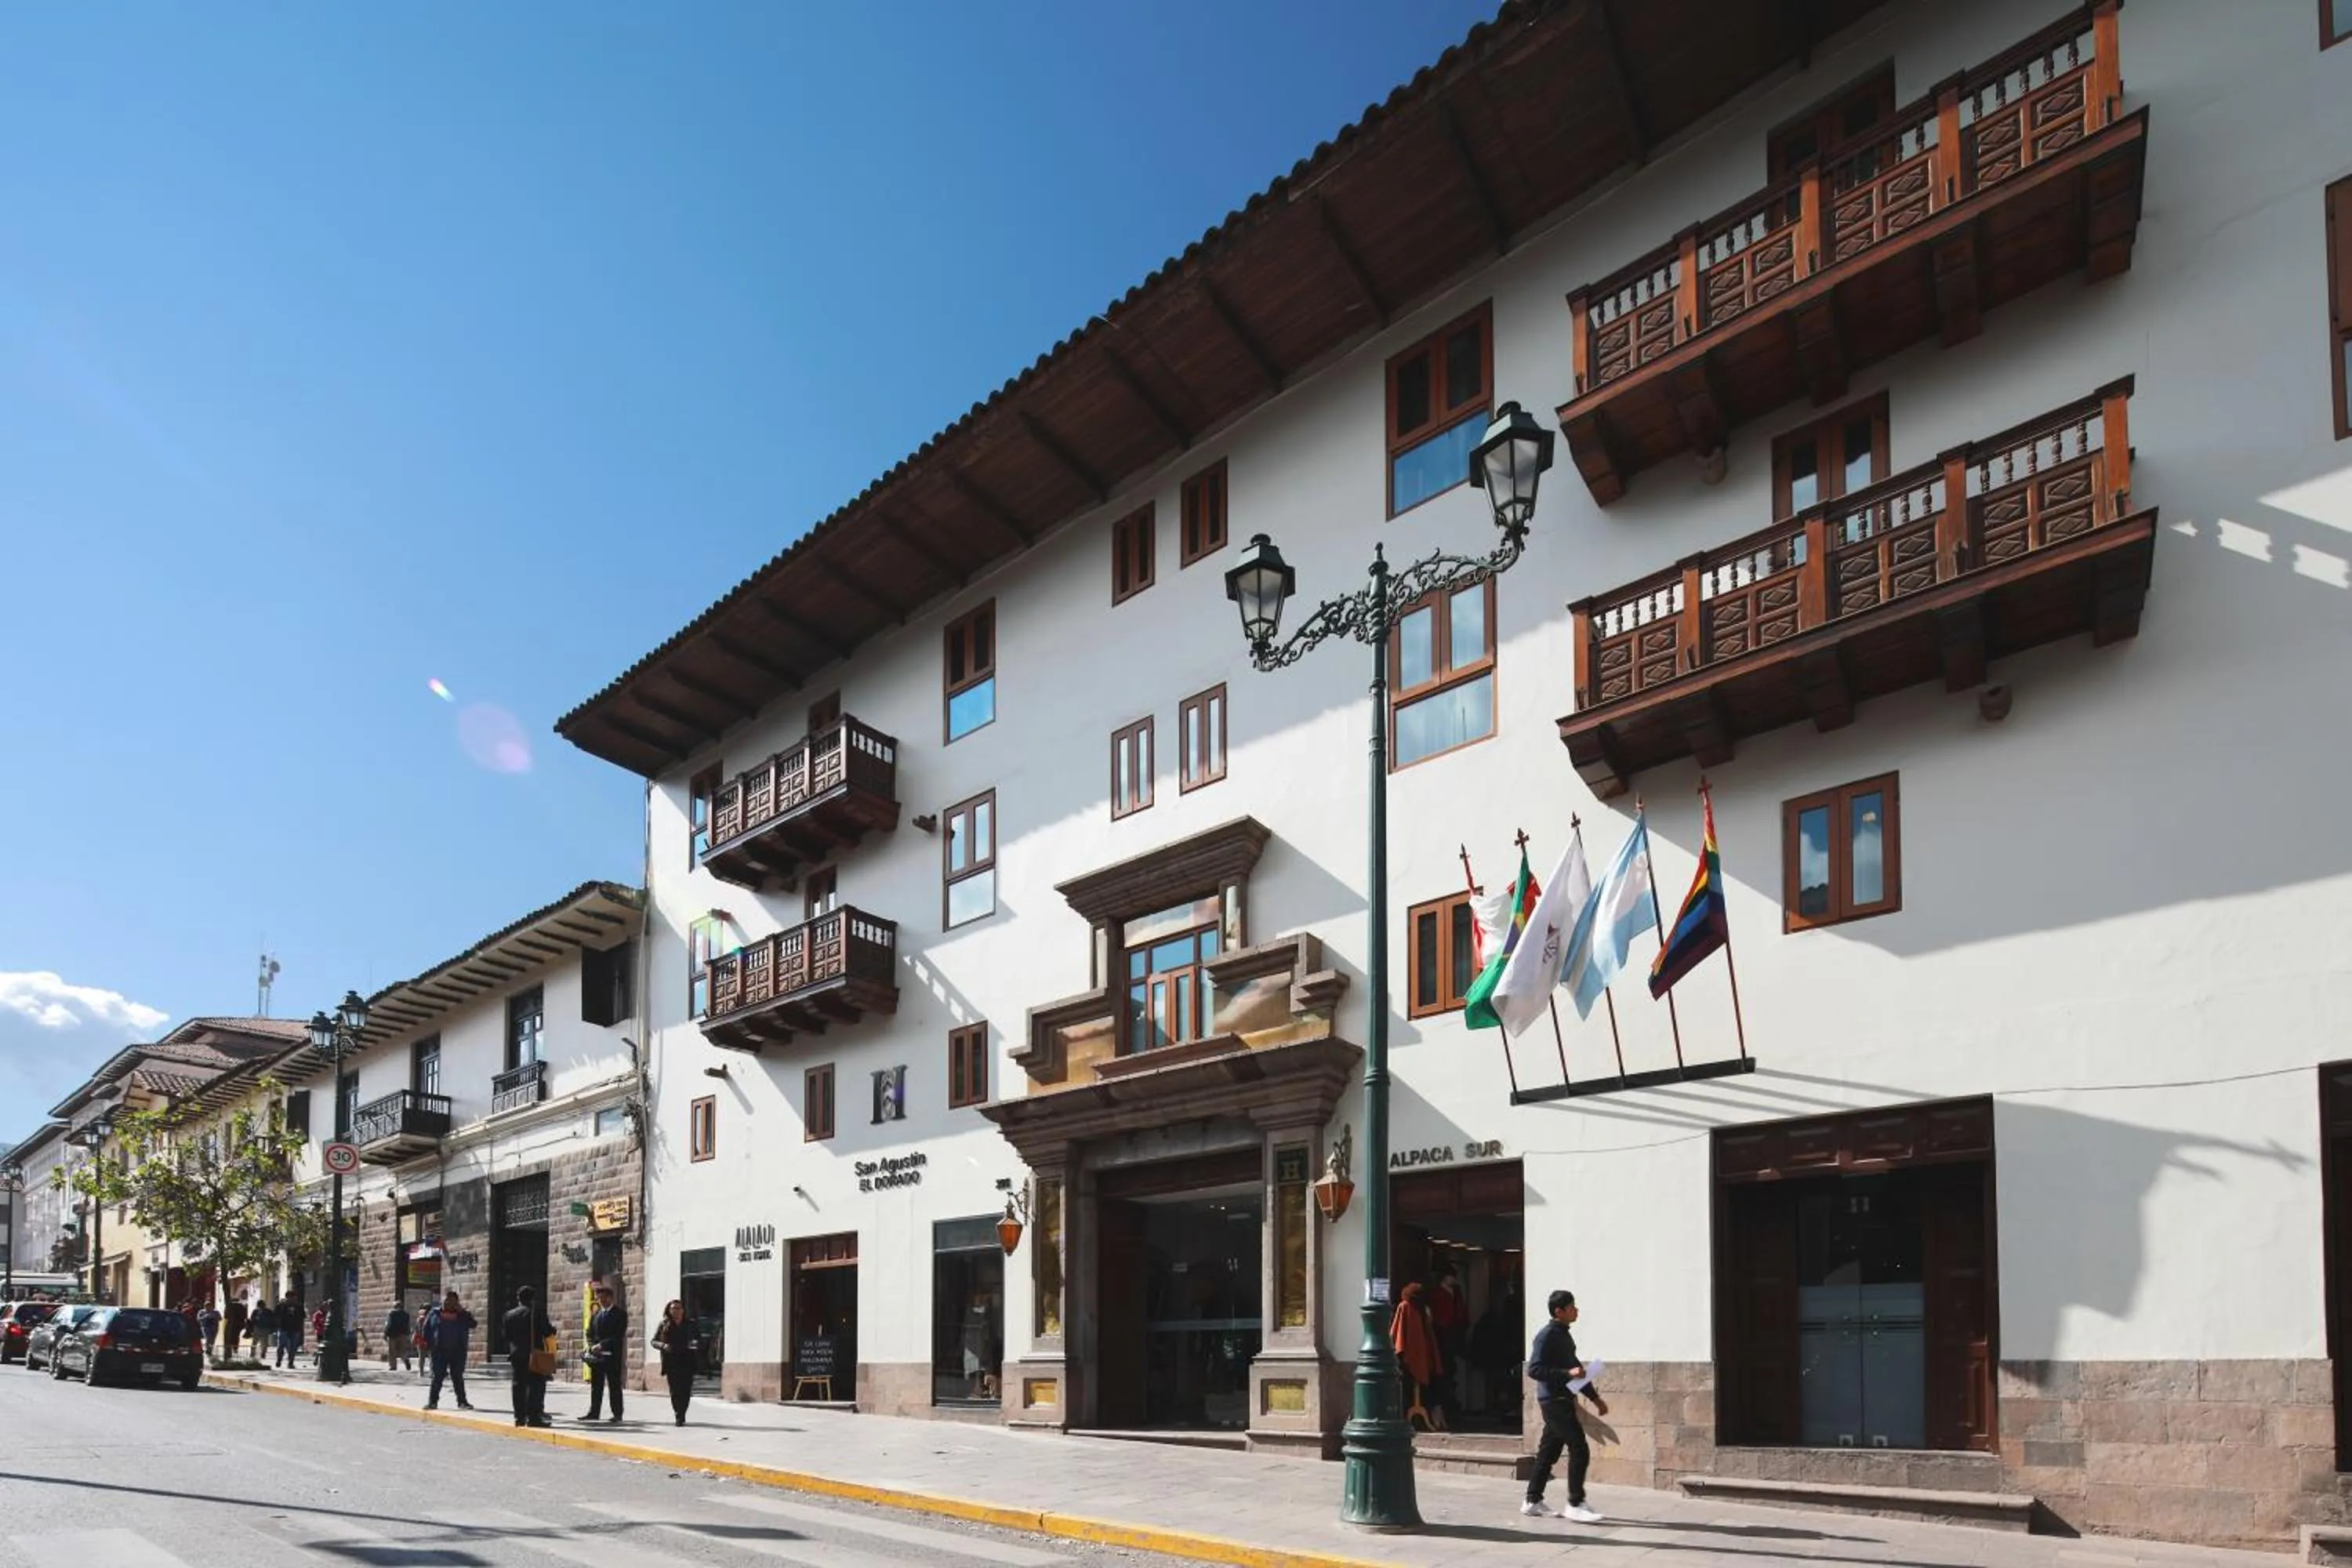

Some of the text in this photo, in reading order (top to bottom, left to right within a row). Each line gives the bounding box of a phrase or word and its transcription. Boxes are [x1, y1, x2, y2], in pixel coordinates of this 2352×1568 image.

[332, 1150, 351, 1162] 30
[1390, 1139, 1504, 1167] ALPACA SUR
[855, 1161, 877, 1177] San
[859, 1171, 921, 1192] EL DORADO
